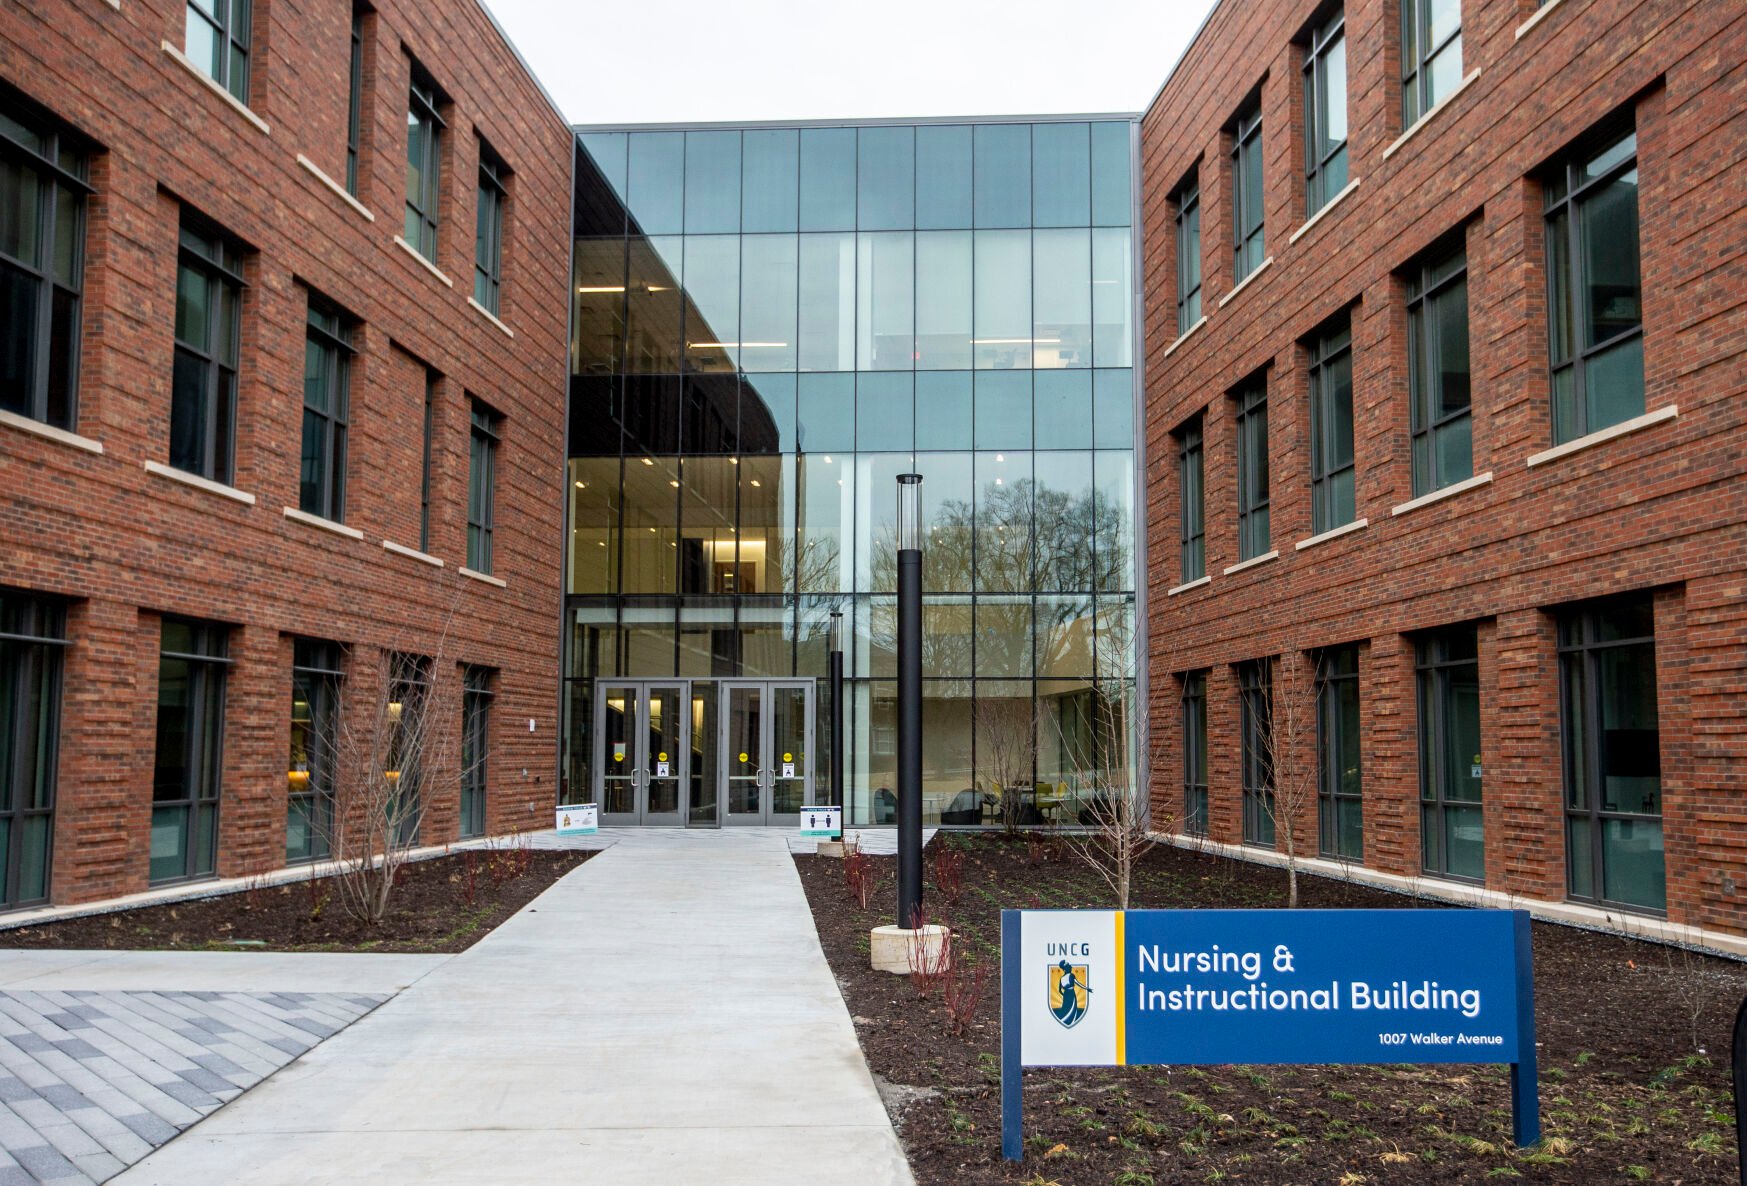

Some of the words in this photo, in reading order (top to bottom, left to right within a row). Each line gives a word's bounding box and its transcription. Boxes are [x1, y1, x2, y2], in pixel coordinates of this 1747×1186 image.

[1047, 943, 1089, 956] UNCG
[1138, 945, 1260, 980] Nursing
[1272, 945, 1295, 973] &
[1138, 981, 1339, 1011] Instructional
[1351, 981, 1481, 1017] Building
[1379, 1033, 1407, 1045] 1007
[1410, 1033, 1454, 1045] Walker
[1457, 1033, 1503, 1045] Avenue
